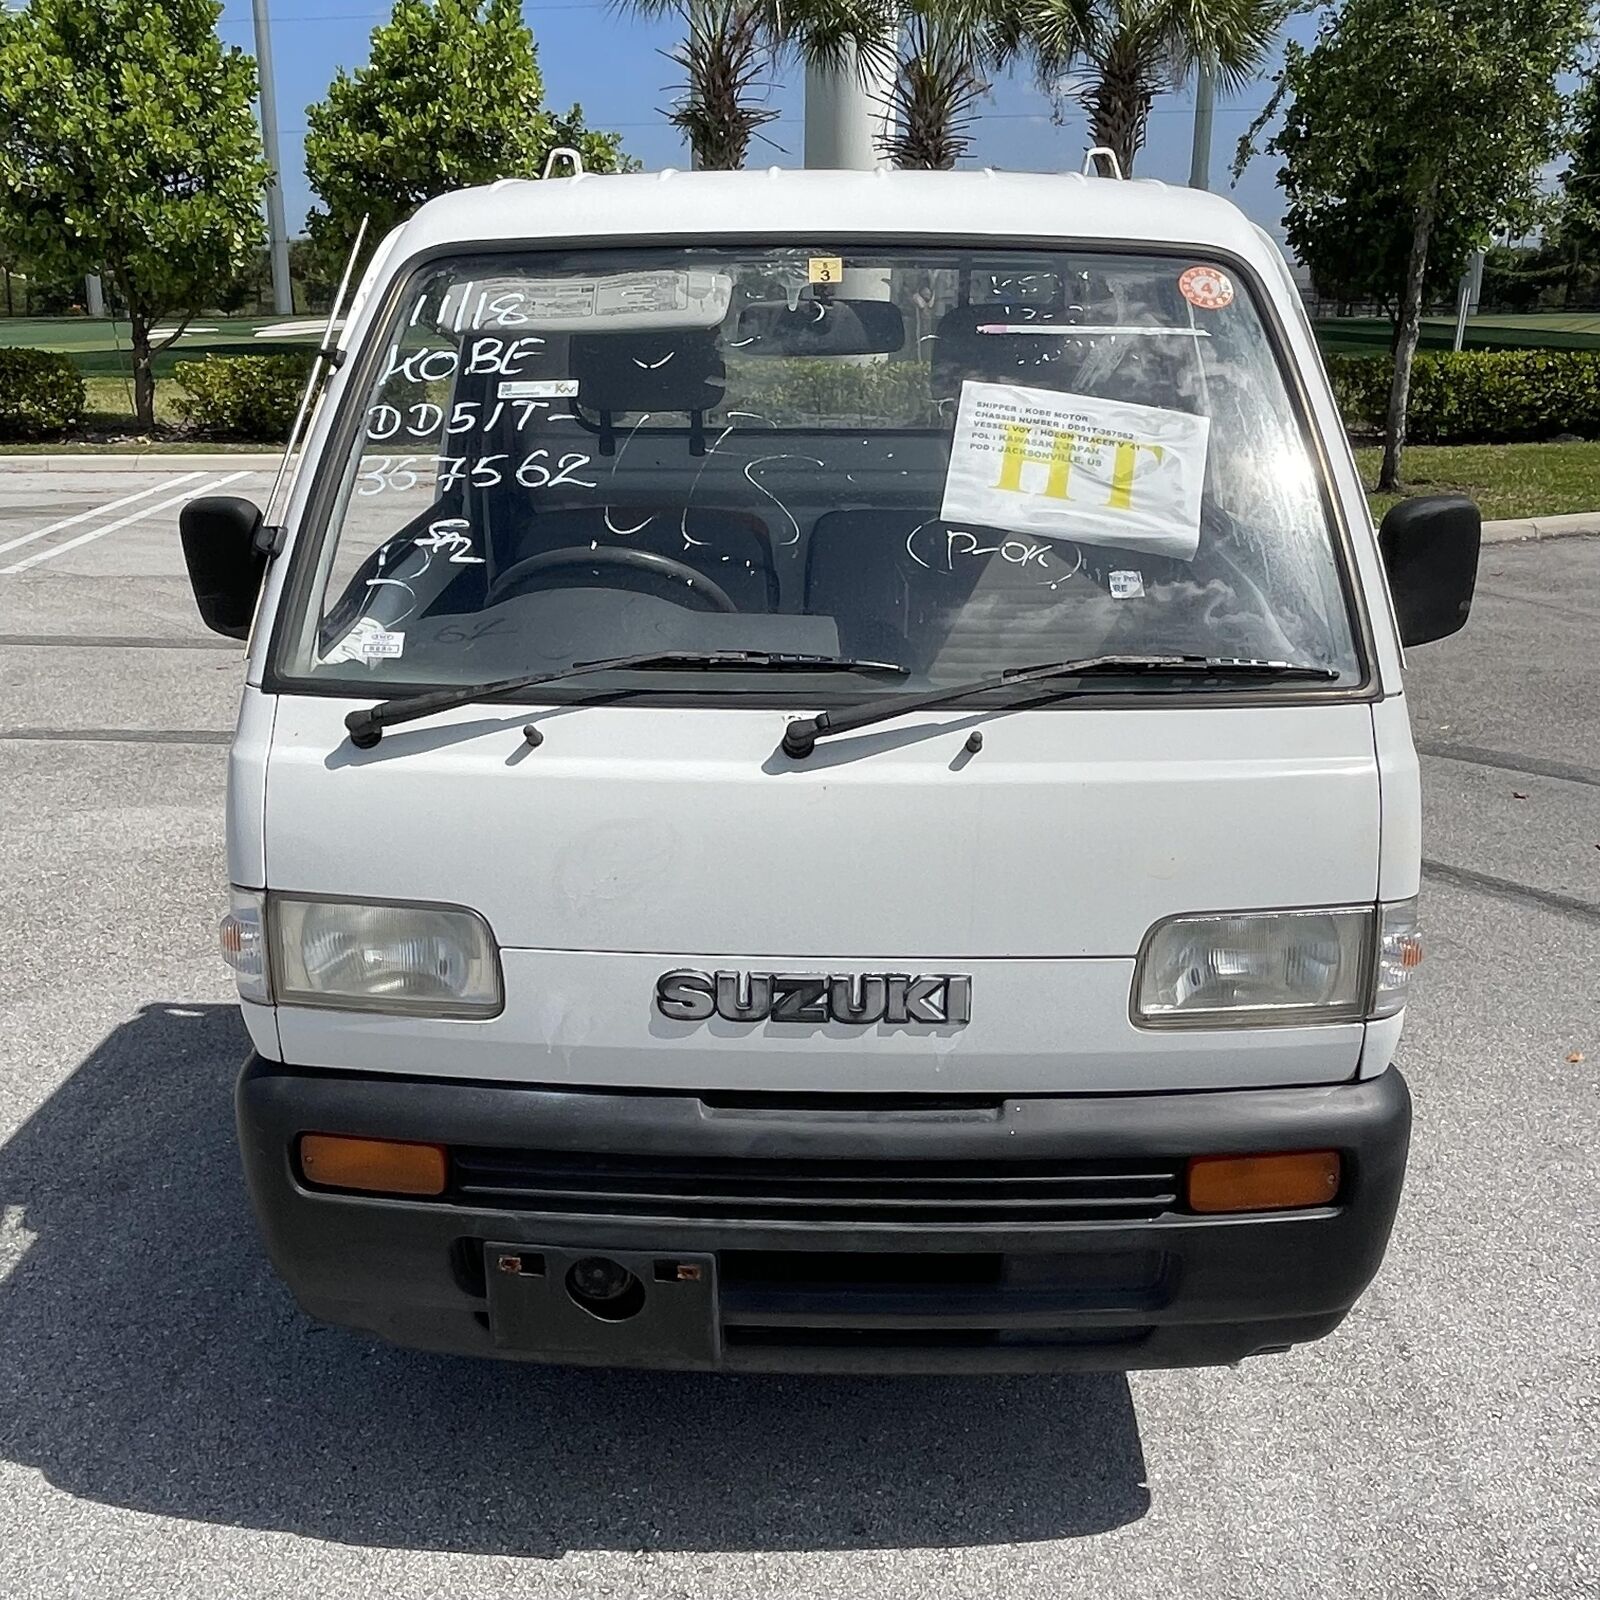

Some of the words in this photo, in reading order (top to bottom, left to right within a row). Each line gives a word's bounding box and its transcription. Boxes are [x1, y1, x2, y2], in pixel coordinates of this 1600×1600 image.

[820, 269, 831, 281] 3
[1201, 283, 1214, 294] 4
[378, 337, 546, 387] KOBE
[974, 411, 1016, 422] CHASSIS
[1018, 416, 1060, 428] NUMBER
[976, 401, 1017, 412] SHIPPER
[1025, 407, 1052, 417] KOBE
[1054, 411, 1089, 422] MOTOR
[971, 431, 990, 440] POL
[1064, 441, 1100, 455] JAPAN
[973, 420, 1010, 431] VESSEL
[1011, 425, 1033, 434] VOY
[1077, 434, 1115, 447] TRACER
[969, 443, 990, 451] POD
[1087, 457, 1102, 467] US
[356, 450, 597, 496] 367562
[656, 967, 973, 1025] SUZUKI
